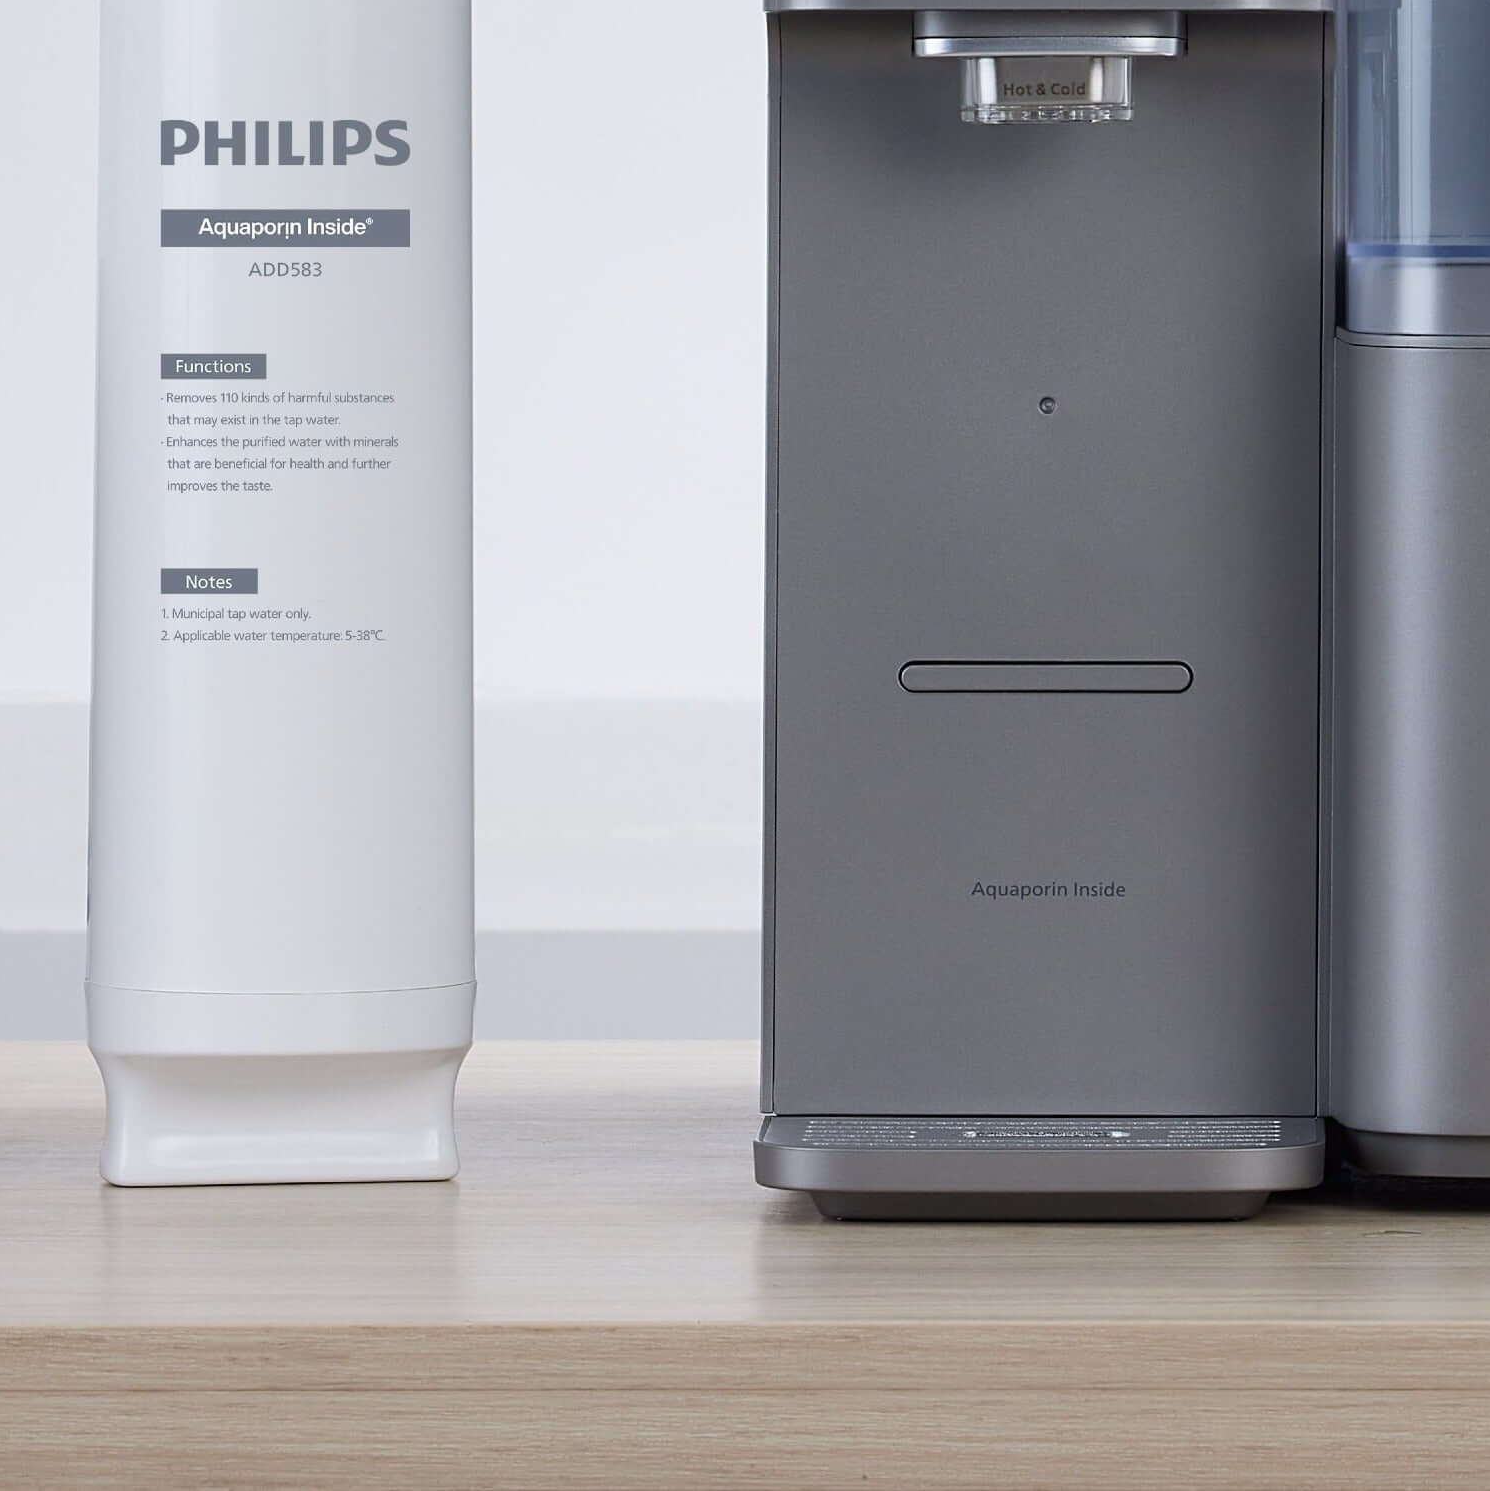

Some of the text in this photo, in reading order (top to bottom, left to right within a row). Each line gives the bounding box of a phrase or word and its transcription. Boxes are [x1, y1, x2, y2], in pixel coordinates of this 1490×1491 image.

[1004, 83, 1086, 96] Hot & Cold
[160, 119, 411, 166] PHILIPS
[248, 262, 323, 277] ADD583
[176, 359, 252, 374] Functions
[166, 392, 394, 403] Removes 110 kinds of harmful substances
[167, 414, 341, 428] that may exist in the tap water.
[166, 436, 399, 450] Enhances the purified water with minerals
[167, 458, 391, 470] that are beneficial for health and further
[167, 480, 273, 493] improves the taste.
[185, 575, 233, 589] Notes
[172, 608, 224, 620] Municipal
[228, 609, 246, 621] tap
[250, 609, 282, 619] water
[286, 608, 311, 621] only.
[174, 630, 231, 644] Applicable
[234, 631, 267, 641] water
[271, 631, 343, 644] temperature:
[971, 881, 1126, 900] Aquaporin Inside
